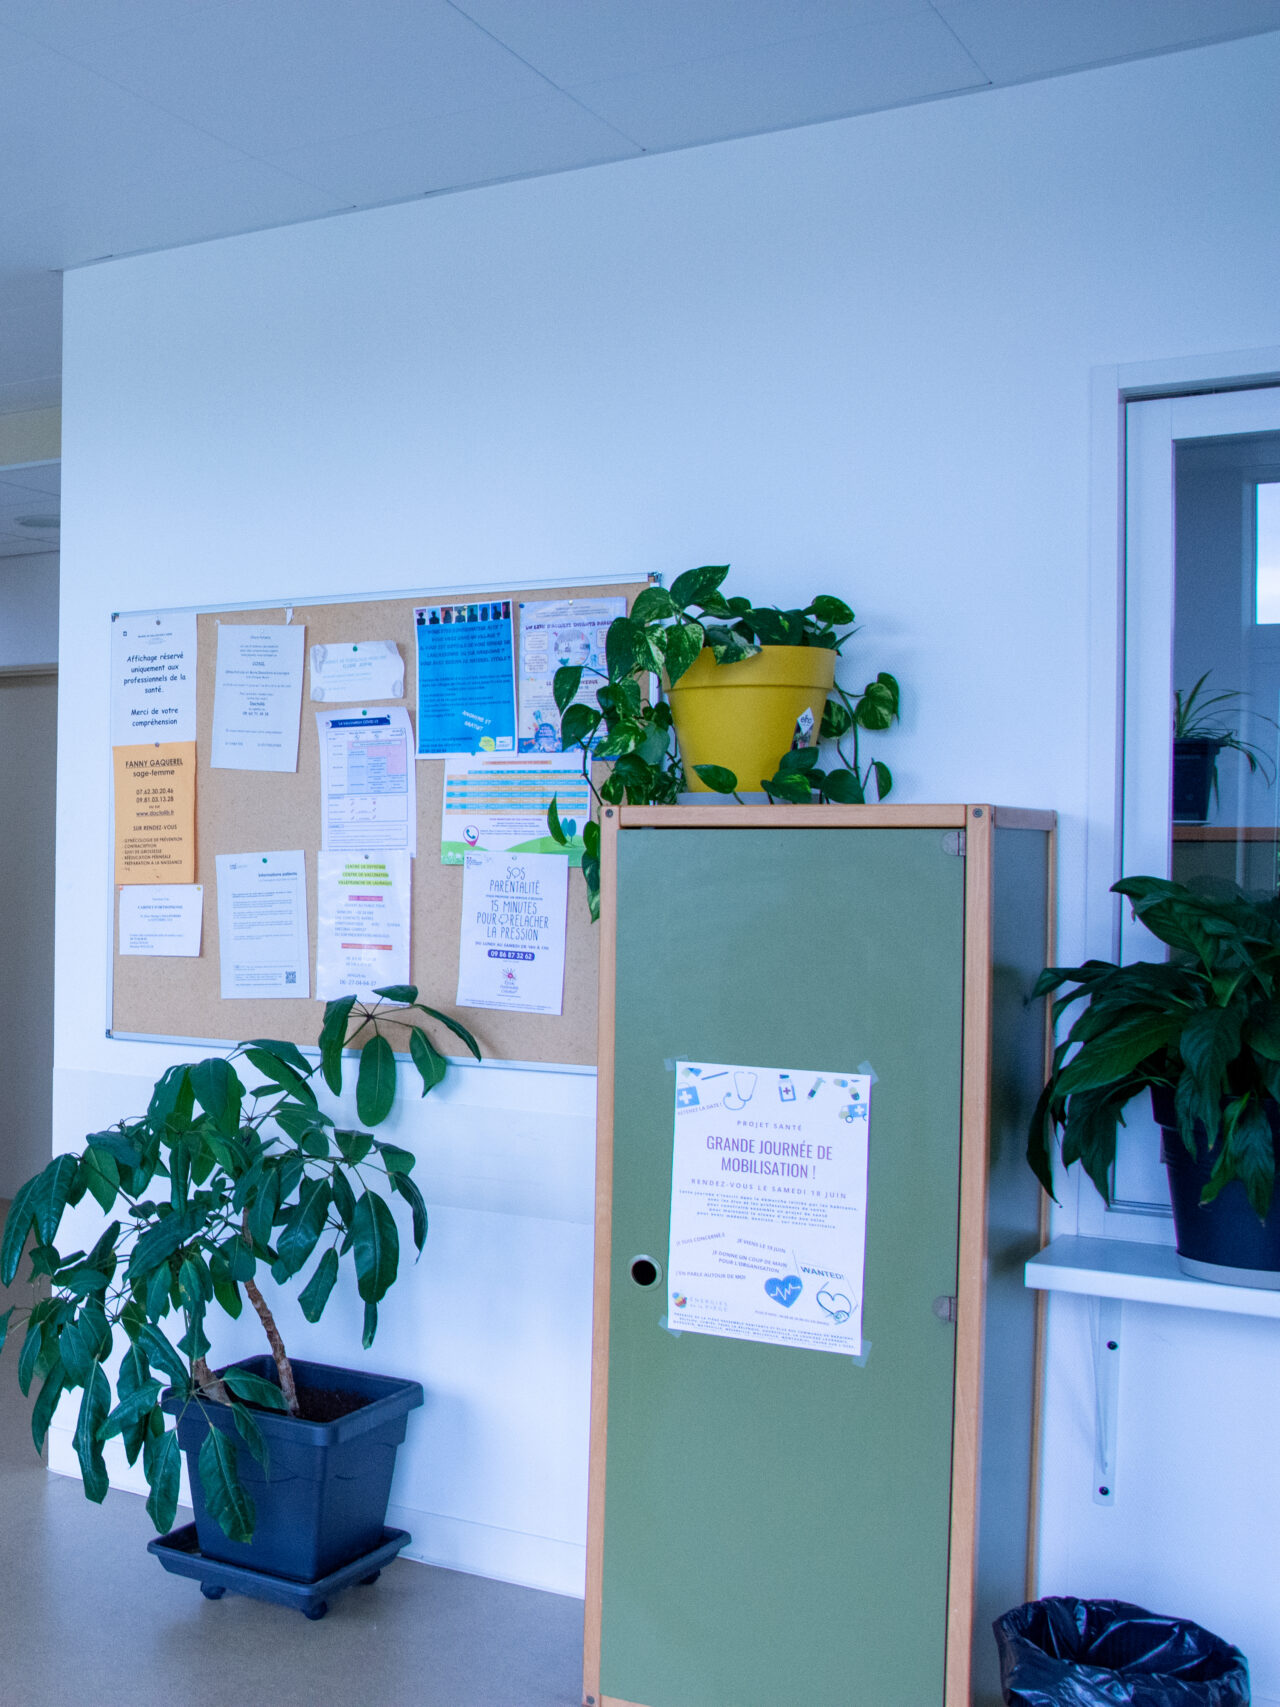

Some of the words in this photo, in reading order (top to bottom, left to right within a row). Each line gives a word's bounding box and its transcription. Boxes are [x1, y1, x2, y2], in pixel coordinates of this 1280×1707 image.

[127, 655, 158, 663] Affichage
[160, 651, 184, 660] réservé
[131, 665, 165, 674] uniquement
[124, 676, 167, 686] professionnels
[132, 718, 178, 727] compréhension
[125, 760, 148, 768] FANNY
[150, 758, 183, 767] GAQUEREL
[133, 769, 175, 778] sage-femme
[506, 866, 526, 880] SOS
[490, 879, 540, 895] PARENTALITÉ
[491, 900, 498, 912] 15
[503, 901, 537, 915] MINUTES
[477, 912, 497, 925] POUR
[510, 914, 549, 928] RELACHER
[487, 926, 497, 938] LA
[501, 927, 539, 941] PRESSION
[736, 1120, 769, 1128] PROJET
[773, 1123, 802, 1132] SANTÉ
[706, 1135, 756, 1153] GRANDE
[758, 1140, 813, 1159] JOURNÉE
[817, 1145, 833, 1160] DE
[721, 1156, 808, 1179] MOBILISATION
[812, 1165, 816, 1179] !
[691, 1178, 753, 1190] RENDEZ-VOUS
[772, 1186, 806, 1195] SAMEDI
[719, 1251, 738, 1259] DONNE
[748, 1256, 763, 1264] COUP
[772, 1260, 788, 1268] MAIN
[734, 1261, 780, 1273] L'ORGANISATION
[800, 1266, 845, 1281] WANTED!
